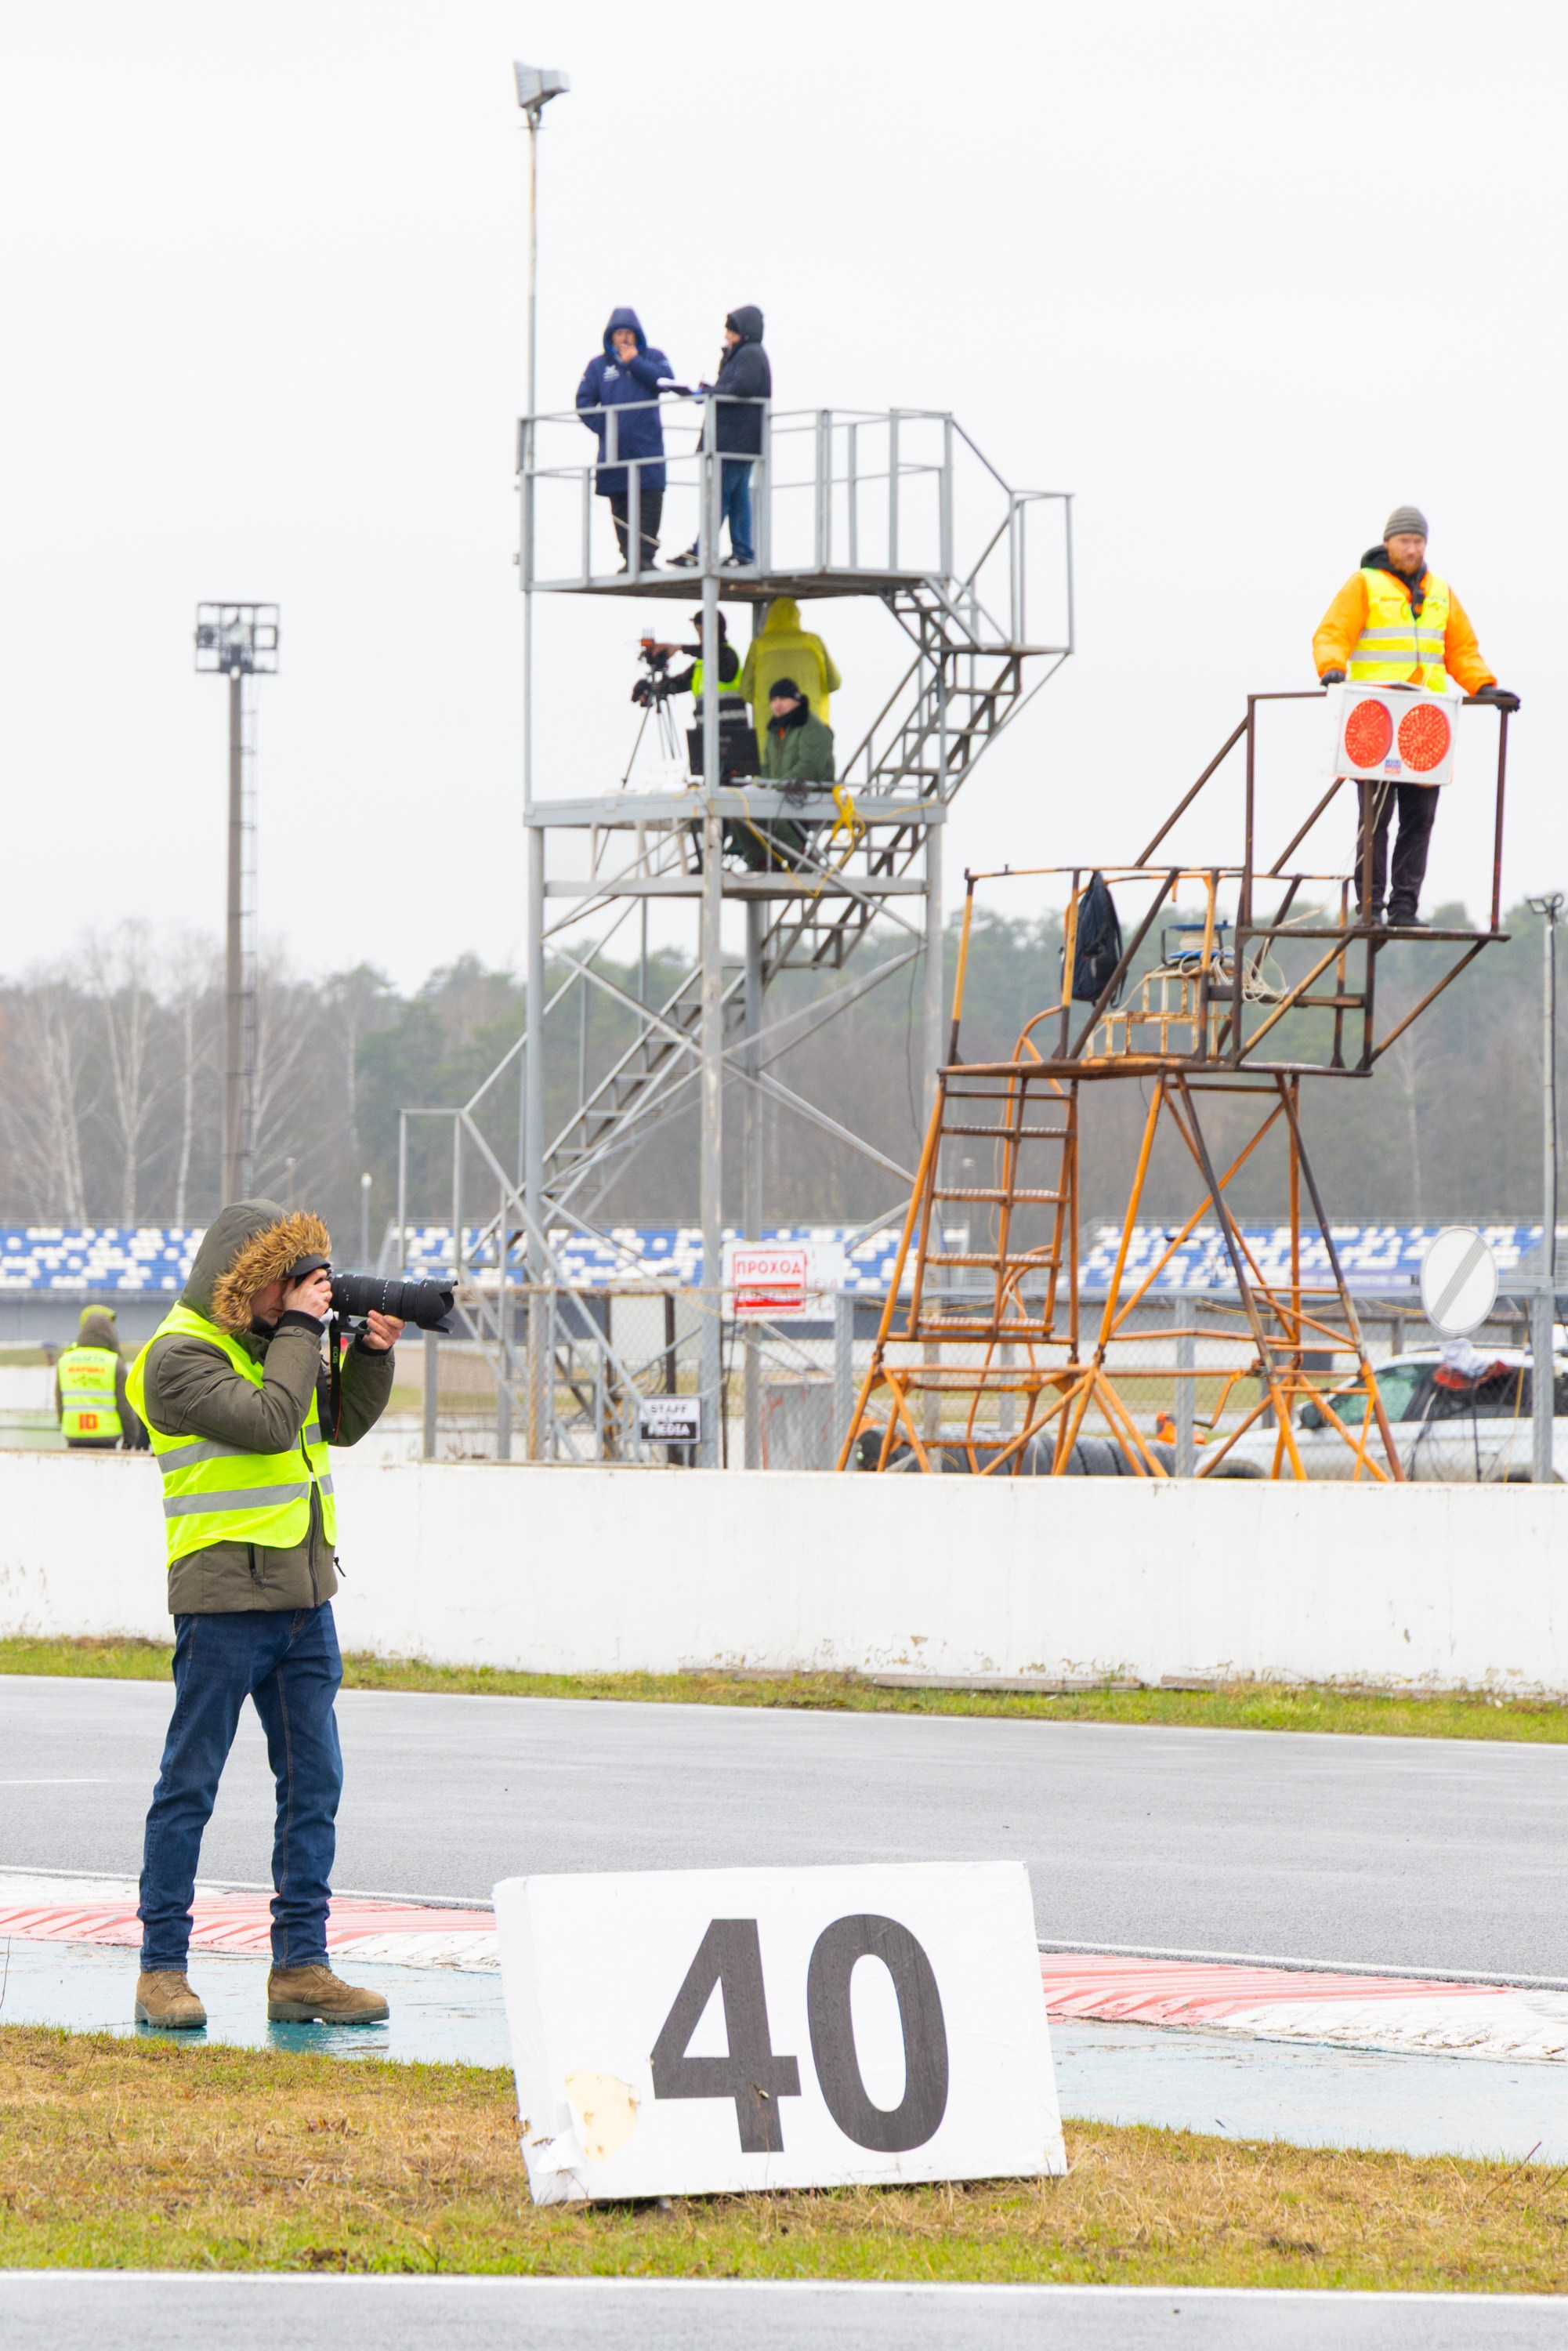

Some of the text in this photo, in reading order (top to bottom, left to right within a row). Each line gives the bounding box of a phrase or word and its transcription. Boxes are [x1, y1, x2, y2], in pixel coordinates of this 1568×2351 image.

[737, 1259, 801, 1275] ПРОХОД
[651, 1404, 687, 1414] STAFF
[650, 1913, 950, 2153] 40
